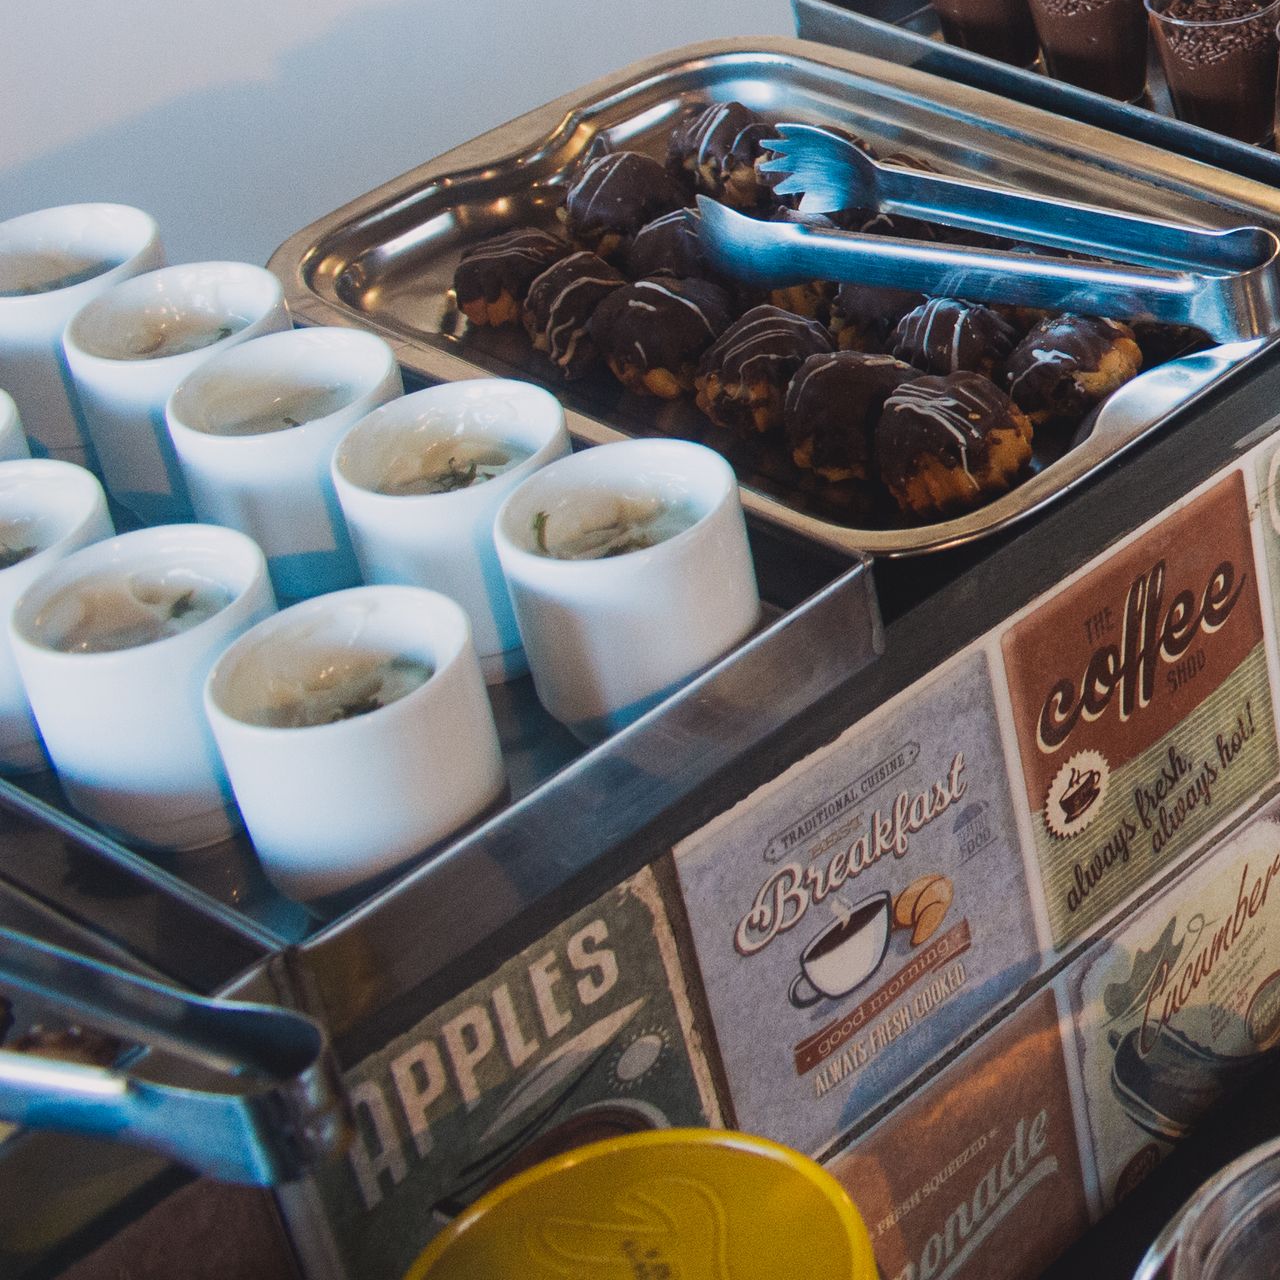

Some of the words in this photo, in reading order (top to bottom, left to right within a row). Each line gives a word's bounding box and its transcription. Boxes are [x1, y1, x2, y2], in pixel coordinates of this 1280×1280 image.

[1036, 558, 1247, 754] coffee
[1083, 606, 1115, 644] THE
[780, 788, 859, 850] TRADITIONAL
[860, 751, 907, 795] CUISINE
[808, 811, 864, 860] BEST
[958, 827, 992, 863] FOOD
[1067, 816, 1137, 913] always
[1134, 745, 1193, 830] fresh,
[1150, 760, 1218, 854] always
[1215, 700, 1256, 769] hot!
[733, 751, 969, 957] Breakfast
[349, 918, 620, 1212] APPLES
[813, 1039, 868, 1098] ALWAYS
[869, 1008, 911, 1053] FRESH
[913, 962, 967, 1017] COOKED
[817, 1006, 867, 1058] good
[866, 938, 949, 1013] morning
[876, 1192, 921, 1237] FRESH
[922, 1135, 988, 1198] SQUEEZED
[893, 1107, 1048, 1279] onade
